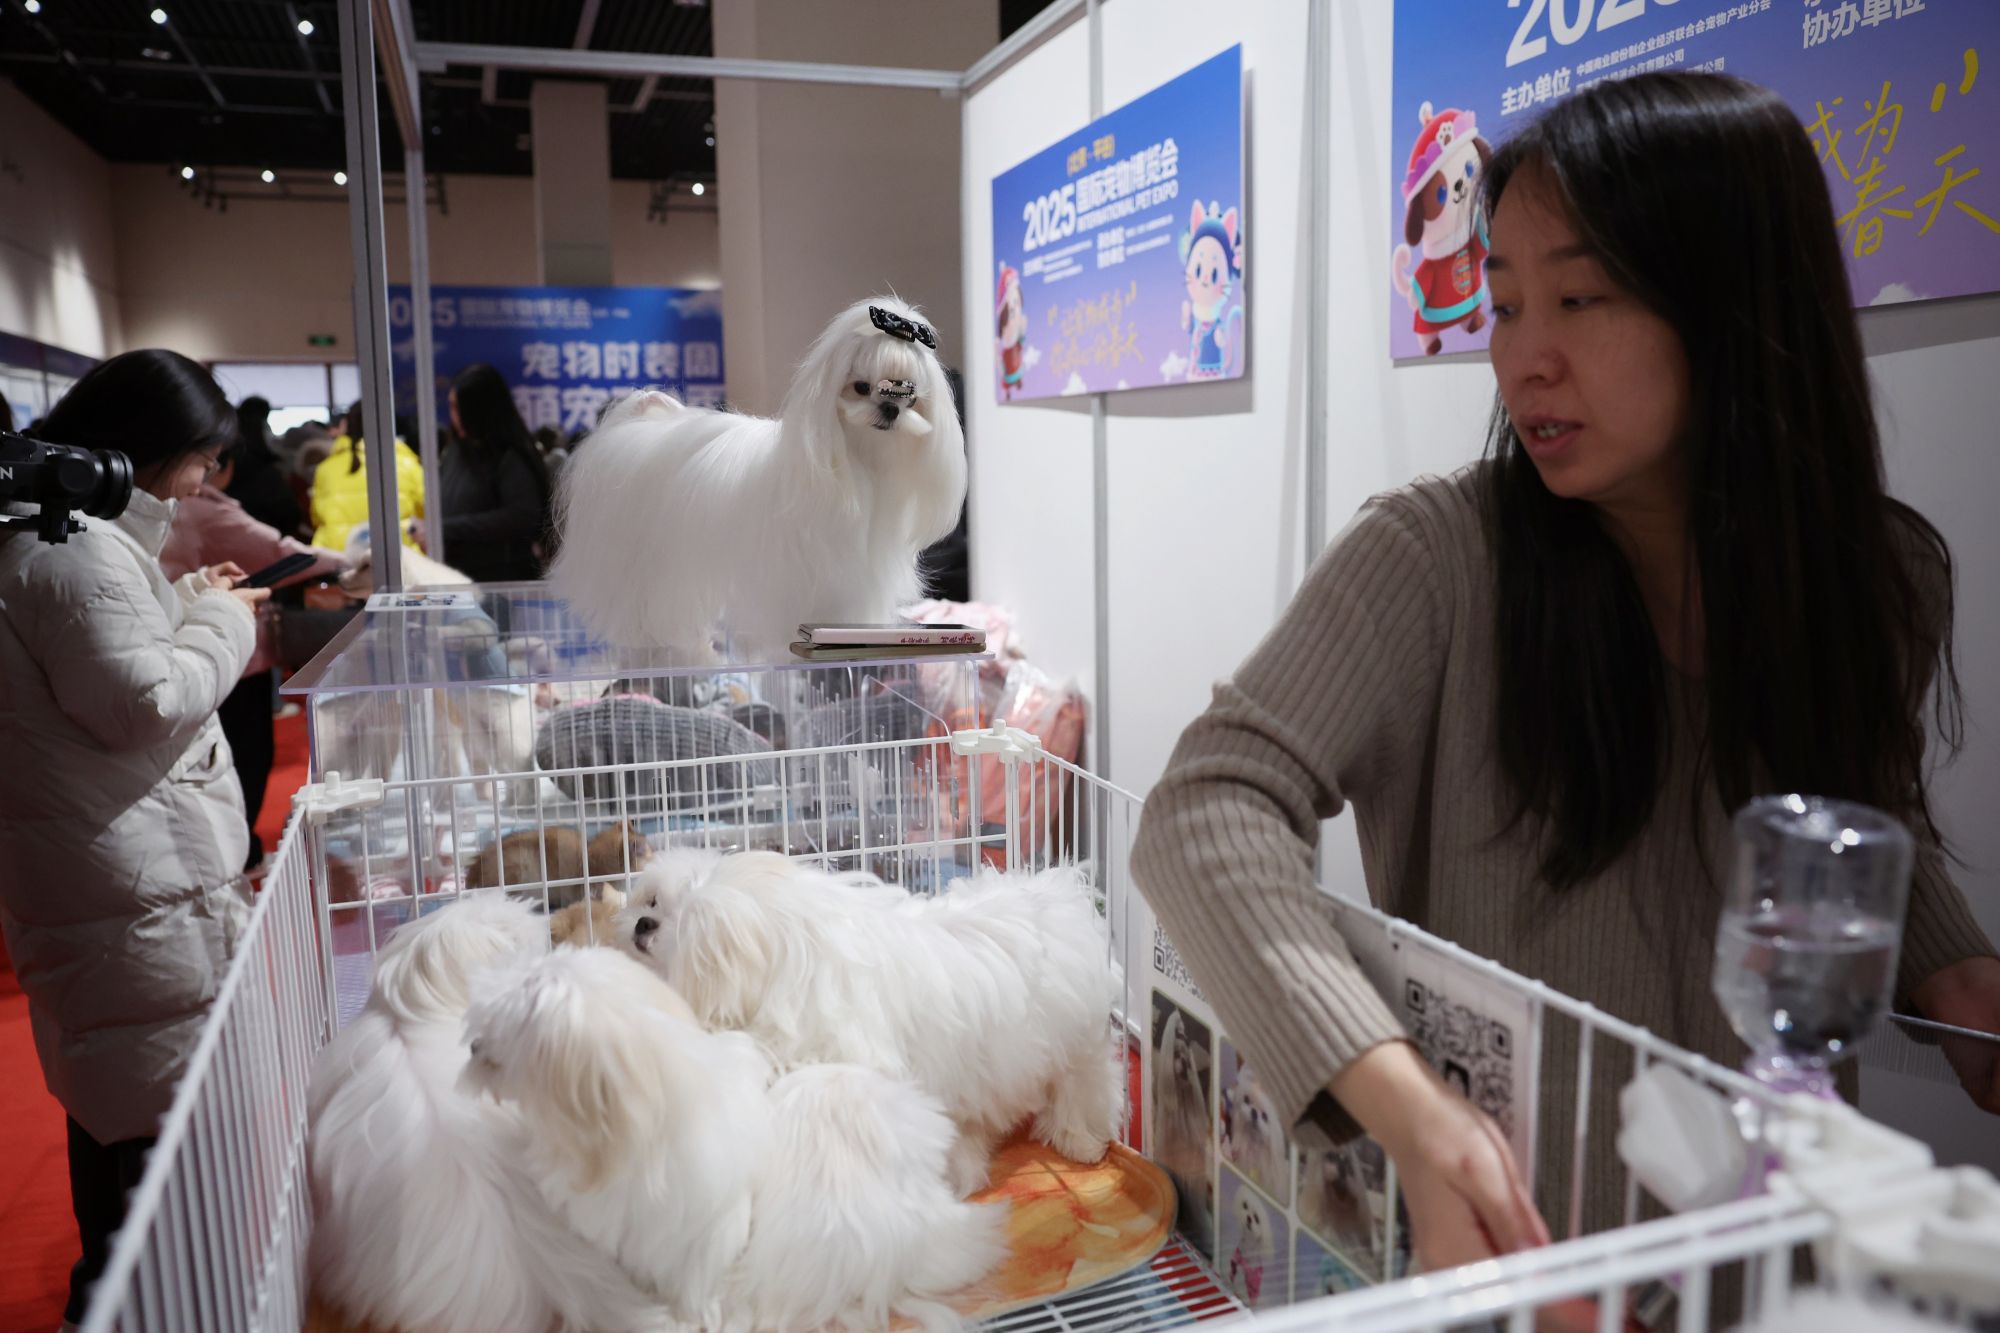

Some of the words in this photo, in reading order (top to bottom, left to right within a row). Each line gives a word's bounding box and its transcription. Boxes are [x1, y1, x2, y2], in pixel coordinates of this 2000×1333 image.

[1500, 66, 1571, 116] 主办单位
[1023, 182, 1076, 252] 2025
[1835, 143, 2000, 258] 春天
